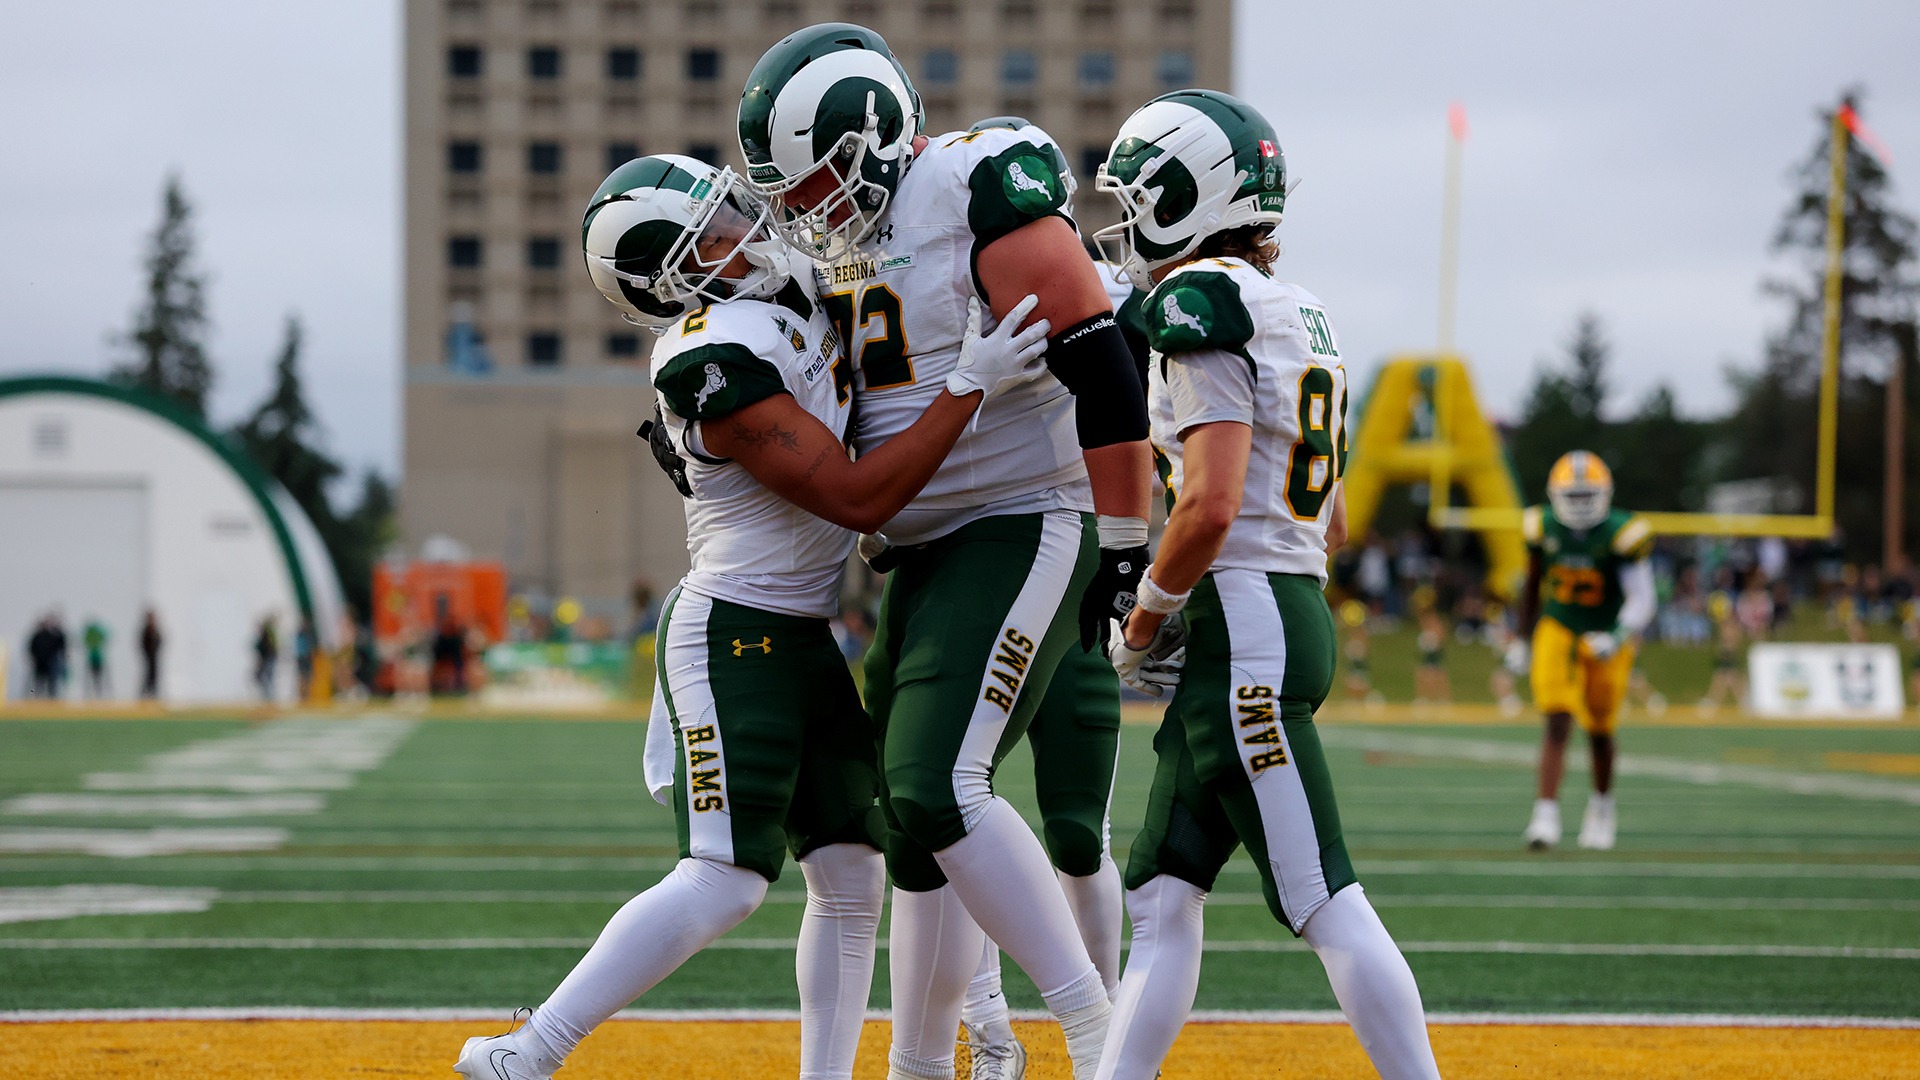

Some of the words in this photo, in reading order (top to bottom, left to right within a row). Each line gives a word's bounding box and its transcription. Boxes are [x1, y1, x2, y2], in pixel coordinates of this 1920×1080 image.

[834, 260, 876, 284] REGINA
[681, 304, 711, 339] 2
[821, 282, 916, 391] 72
[1283, 364, 1349, 522] 8
[983, 627, 1034, 715] RAMS
[686, 724, 724, 813] RAMS
[1236, 685, 1289, 774] RAMS
